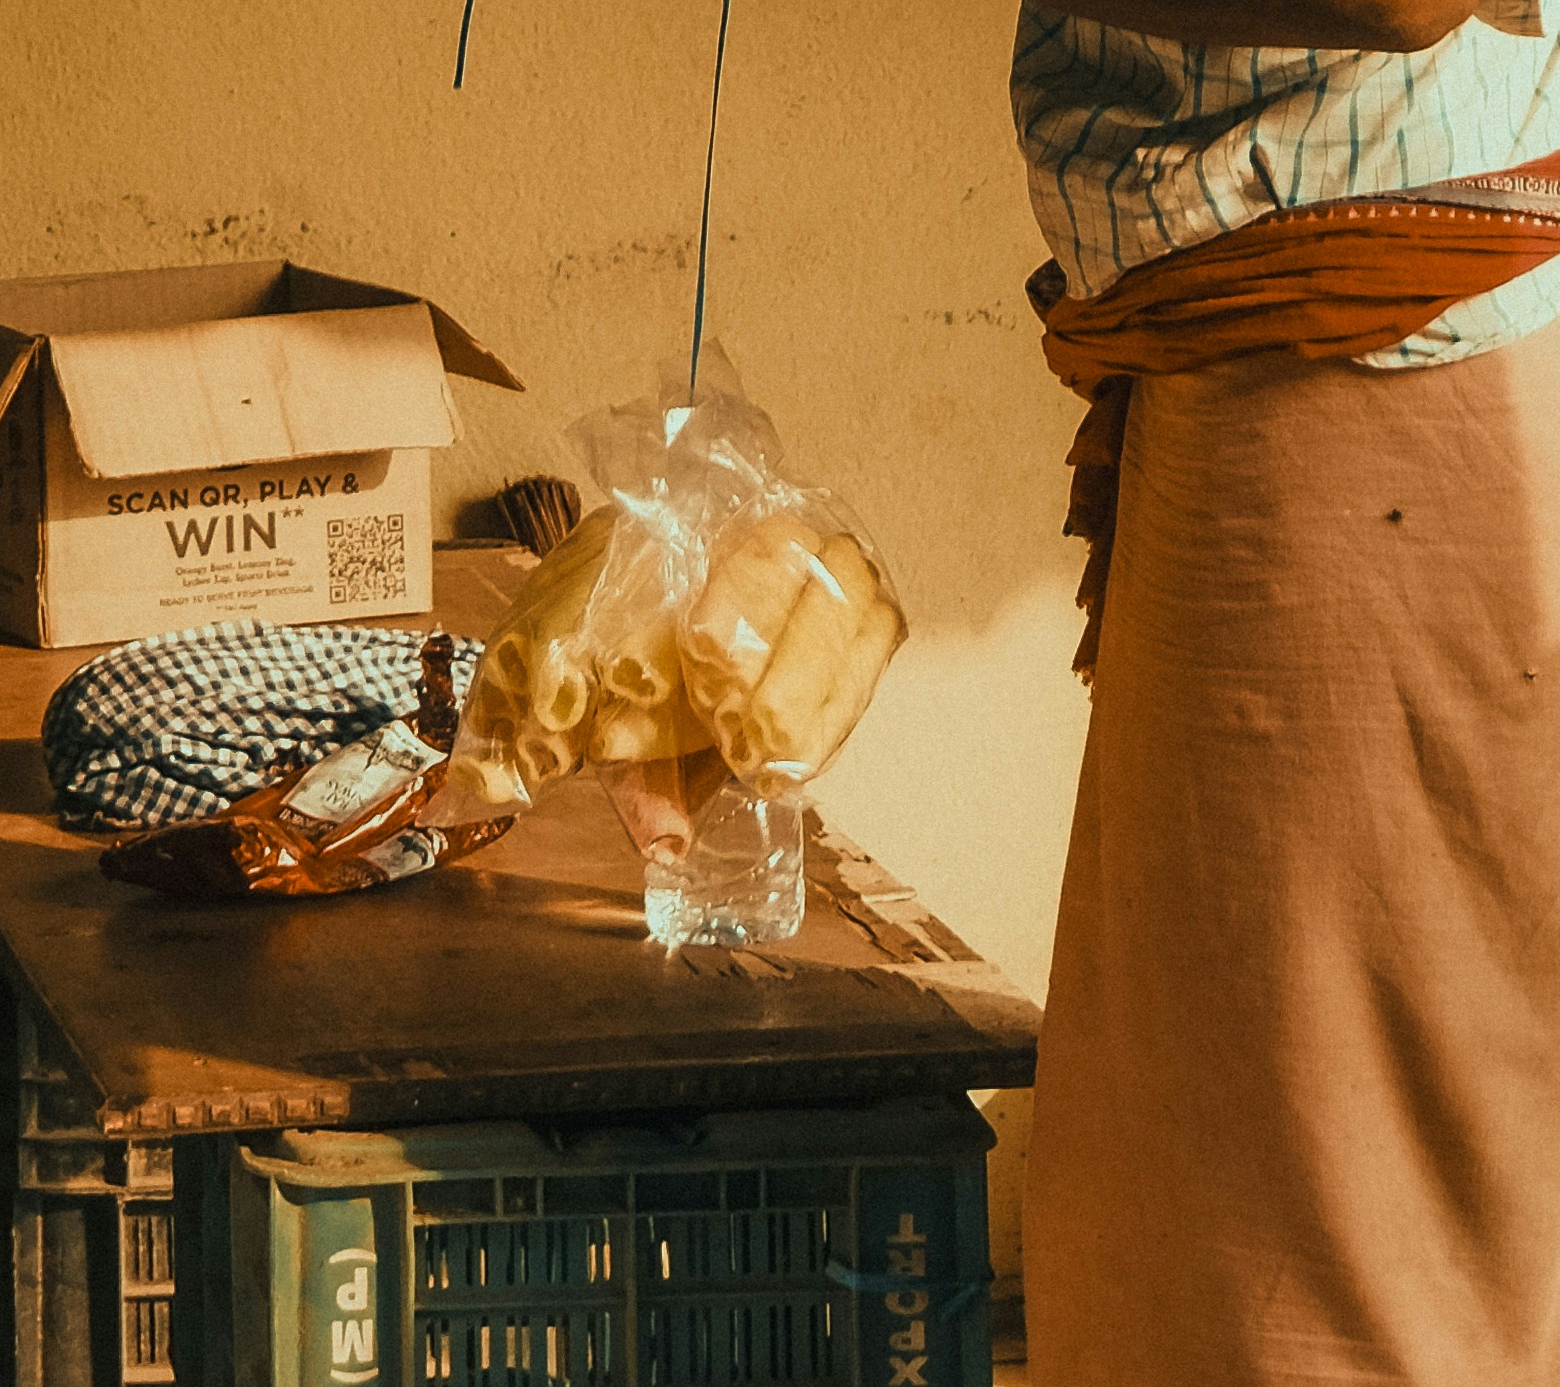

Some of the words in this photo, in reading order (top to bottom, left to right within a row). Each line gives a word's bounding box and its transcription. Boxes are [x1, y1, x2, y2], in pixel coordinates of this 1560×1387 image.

[107, 488, 190, 516] SCAN
[199, 482, 249, 509] QR,
[259, 474, 333, 502] PLAY
[341, 472, 360, 495] &
